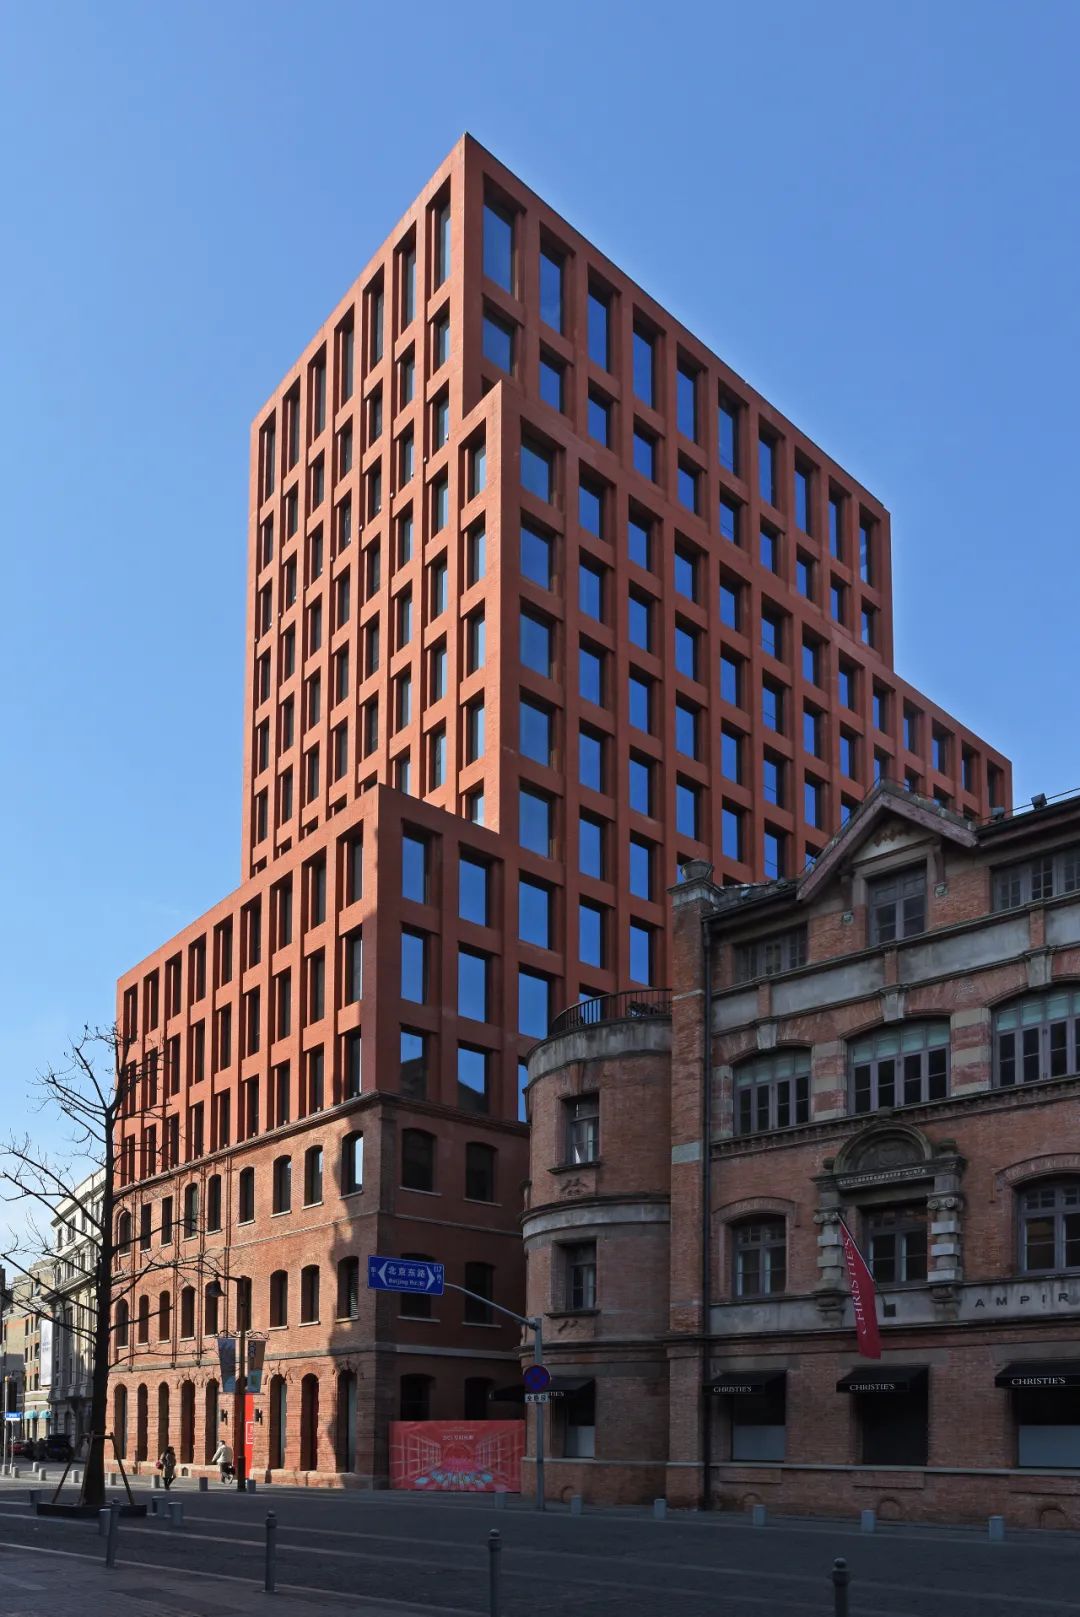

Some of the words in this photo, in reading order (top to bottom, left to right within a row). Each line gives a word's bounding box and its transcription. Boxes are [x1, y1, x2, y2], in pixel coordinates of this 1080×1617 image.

[387, 1266, 425, 1278] 北京东路
[1011, 1377, 1067, 1386] CHRISTIE'S
[713, 1385, 752, 1393] CHRISTIE'S
[849, 1383, 896, 1392] CHRISTIE'S
